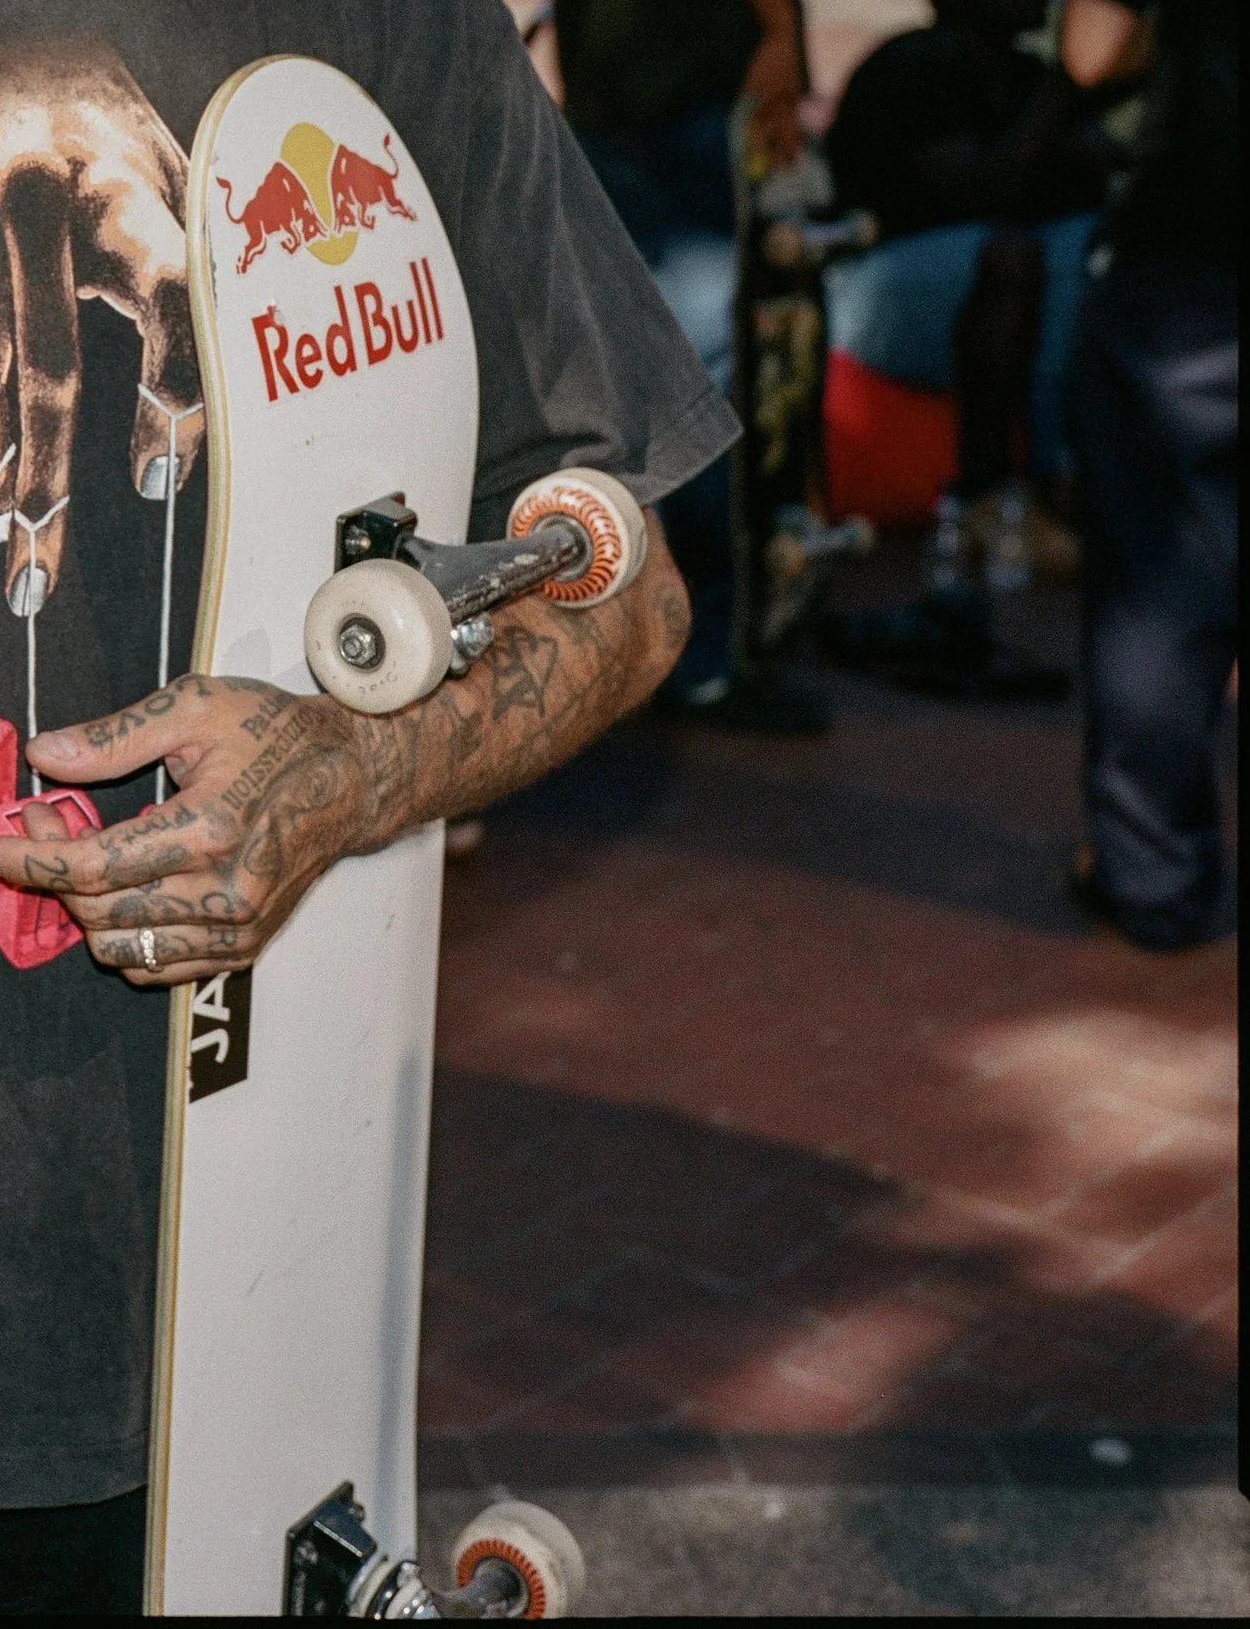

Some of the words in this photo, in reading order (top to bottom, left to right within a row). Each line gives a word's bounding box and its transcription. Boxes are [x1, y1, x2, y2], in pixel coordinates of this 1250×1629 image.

[251, 284, 357, 402] Red
[354, 257, 444, 365] Bull
[190, 971, 231, 1064] JA
